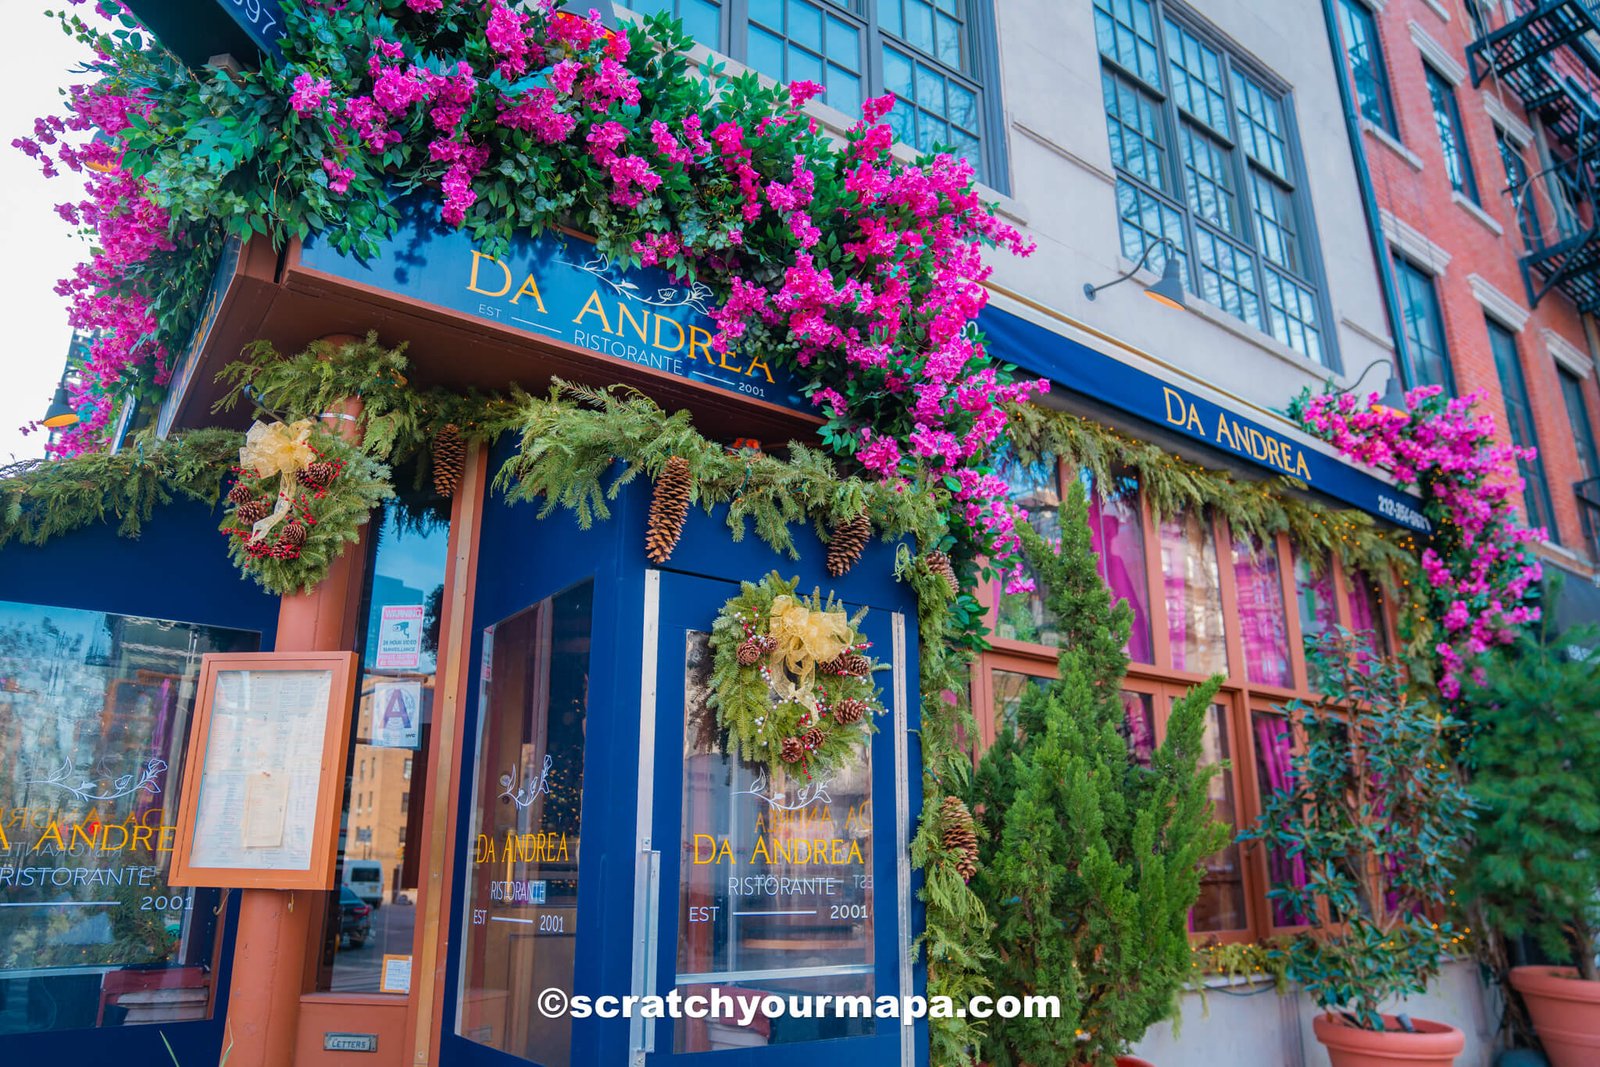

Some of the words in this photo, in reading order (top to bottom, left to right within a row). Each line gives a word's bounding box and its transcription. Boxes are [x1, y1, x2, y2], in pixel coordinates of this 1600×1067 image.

[467, 250, 548, 314] DA
[572, 290, 775, 384] ANDREA
[479, 303, 502, 318] EST
[574, 330, 683, 376] RISTORANTE
[738, 382, 765, 397] 2001
[1163, 386, 1205, 436] DA
[1216, 413, 1312, 480] ANDREA
[385, 609, 421, 618] WARNING
[379, 688, 411, 728] A
[476, 833, 496, 864] DA
[502, 832, 569, 863] ANDREA
[693, 834, 736, 865] DA
[750, 835, 864, 865] ANDREA
[0, 867, 151, 886] RISTORANTE
[728, 877, 836, 896] RISTORANTE
[490, 880, 545, 902] RISTORANTE
[140, 895, 193, 911] 2001
[689, 907, 720, 922] EST
[830, 904, 869, 919] 2001
[473, 909, 488, 925] EST
[540, 914, 564, 933] 2001
[331, 1040, 366, 1049] LETTERS
